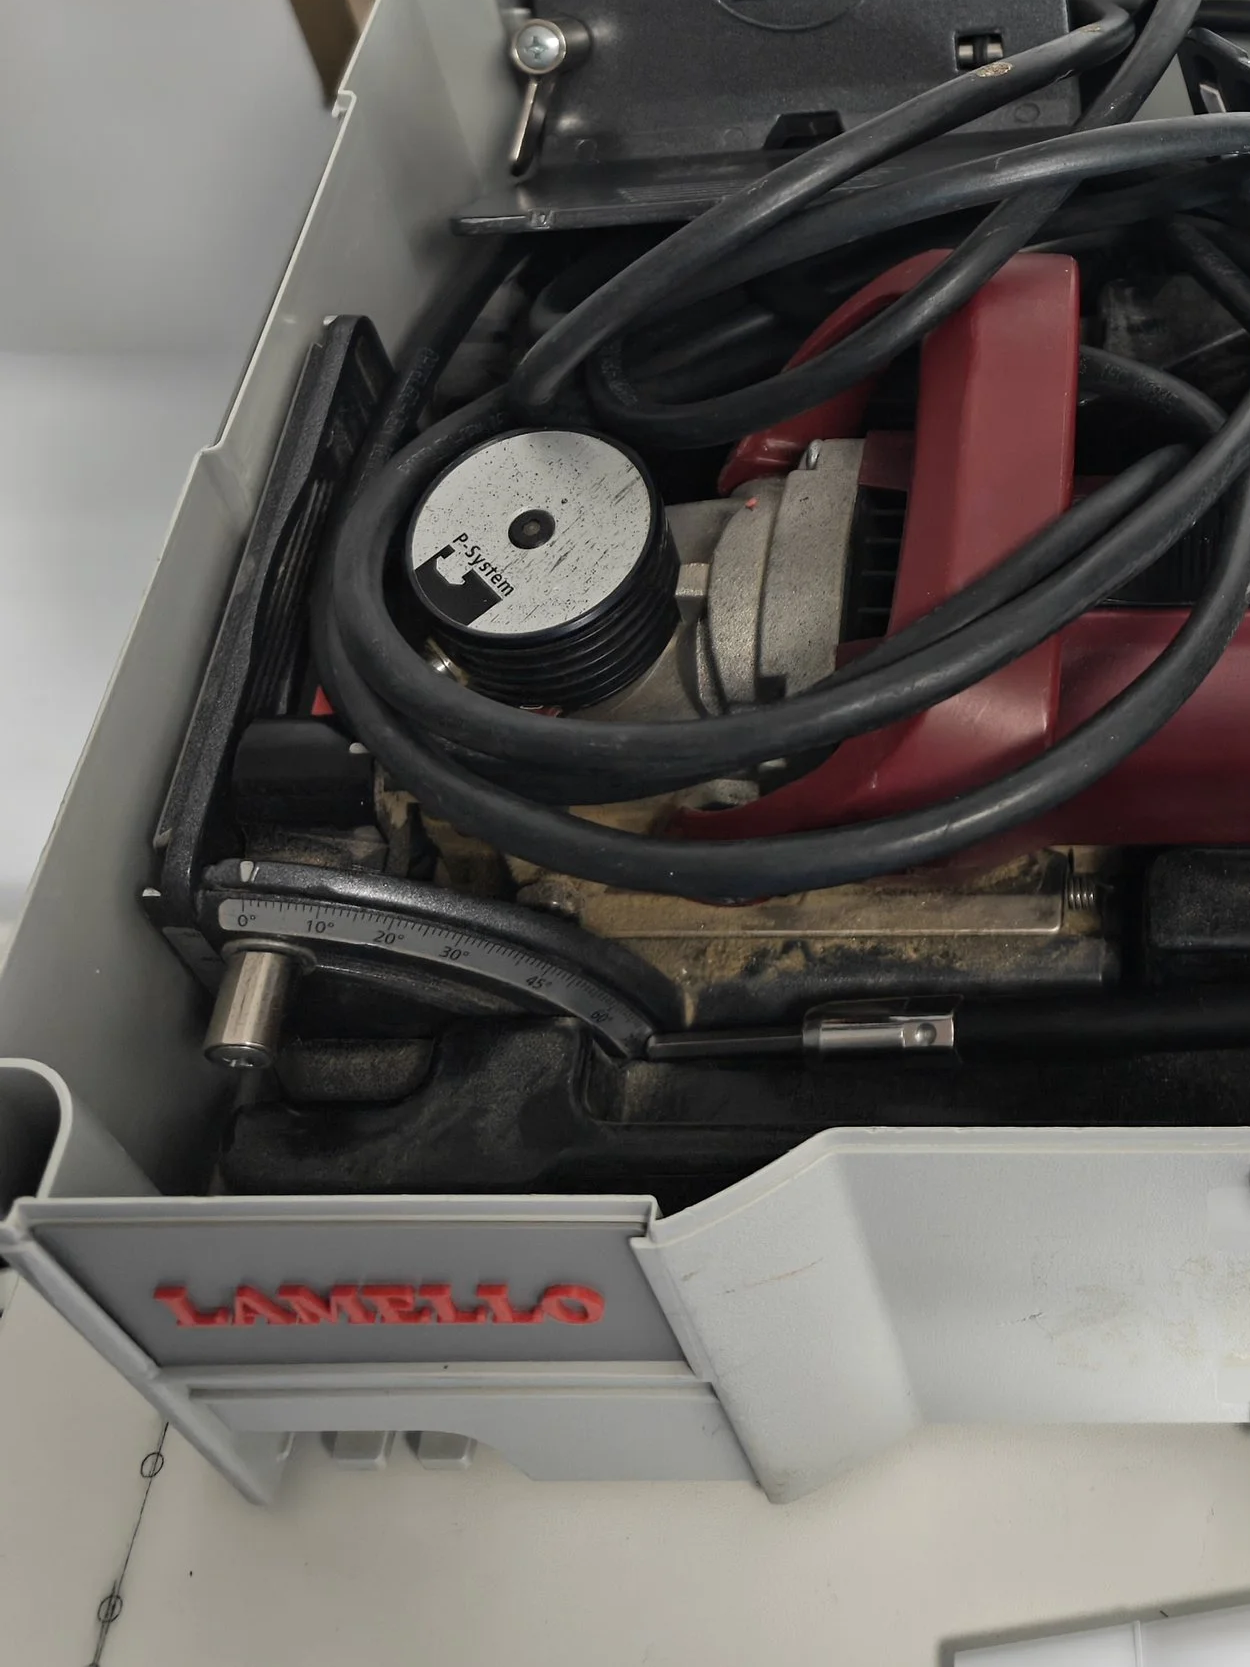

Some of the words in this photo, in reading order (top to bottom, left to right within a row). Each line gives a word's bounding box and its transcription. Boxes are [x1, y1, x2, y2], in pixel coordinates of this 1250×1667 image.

[452, 532, 515, 598] P-System
[237, 914, 256, 928] 0°
[305, 919, 335, 934] 10°
[373, 930, 405, 946] 20°
[438, 945, 471, 962] 30°
[525, 974, 553, 991] 45°
[153, 1282, 606, 1328] LAMELLO
